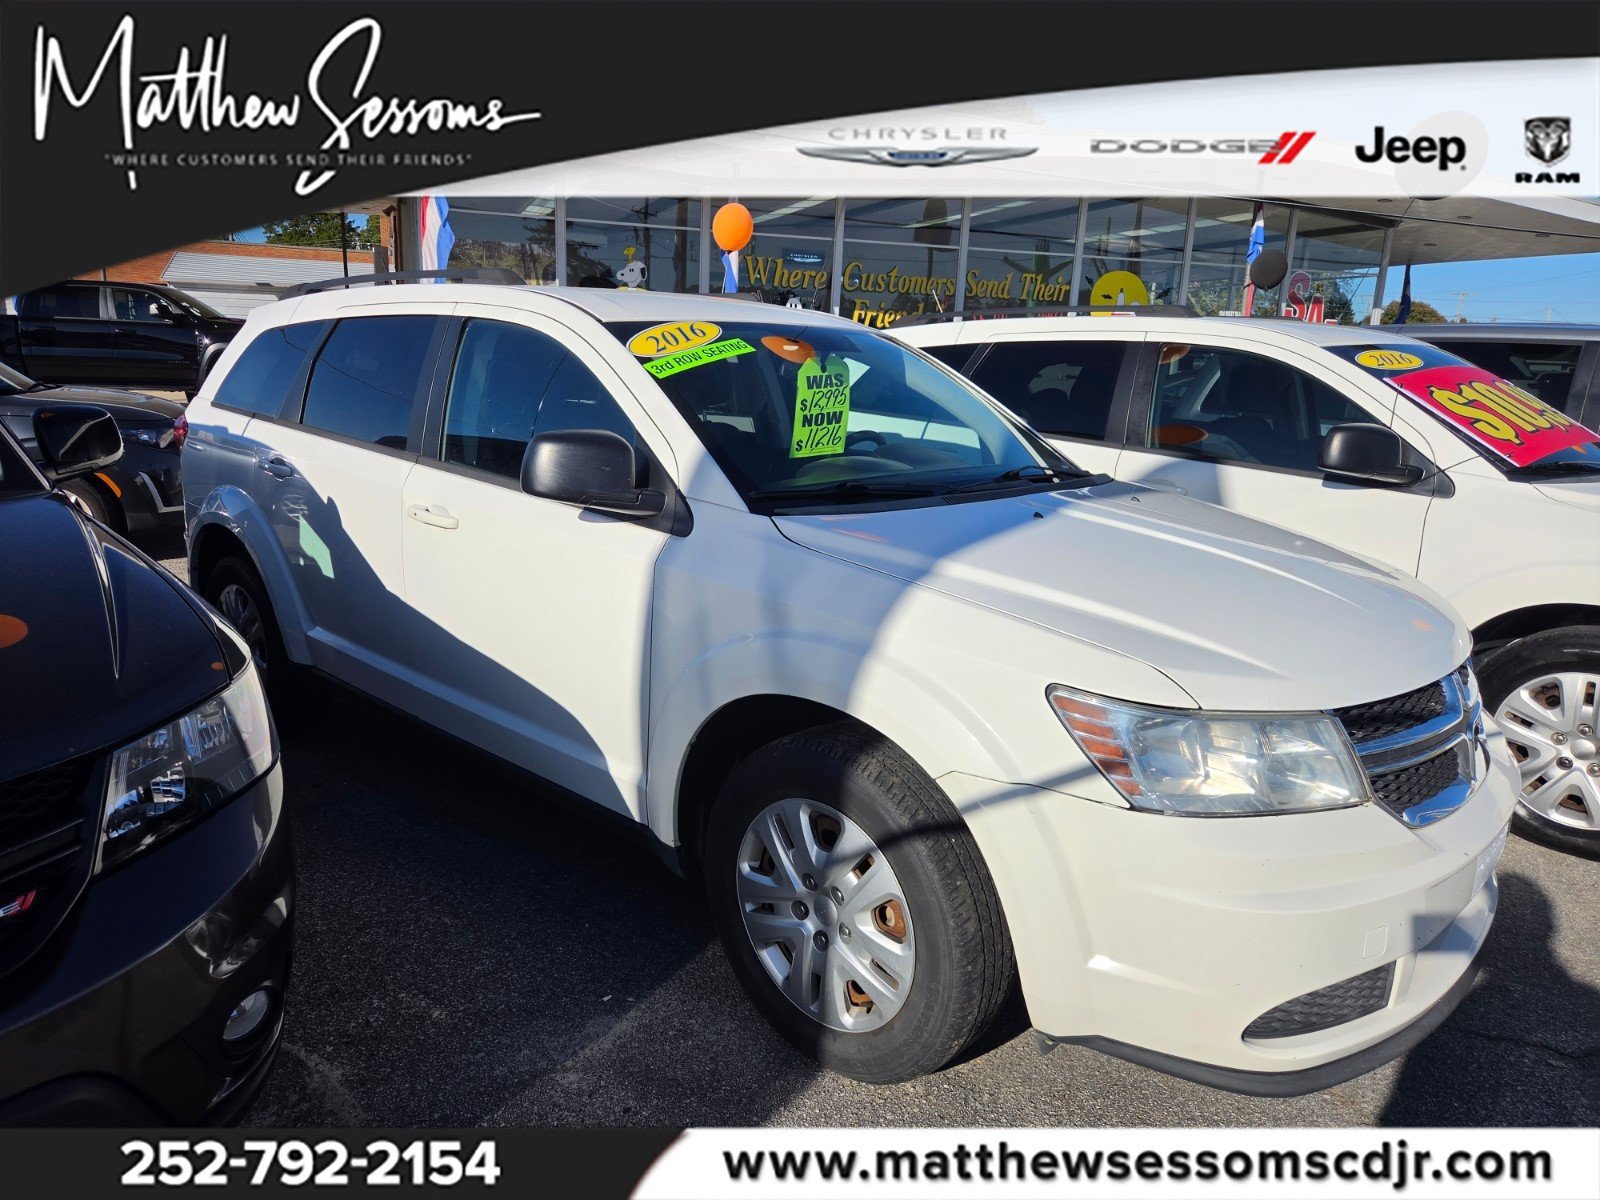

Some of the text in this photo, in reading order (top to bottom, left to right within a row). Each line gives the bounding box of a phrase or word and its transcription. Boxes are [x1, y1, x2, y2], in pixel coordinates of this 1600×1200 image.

[843, 261, 956, 296] Customers
[965, 268, 1014, 300] Send
[1020, 272, 1071, 302] Their
[852, 298, 932, 328] Frie
[1284, 271, 1338, 326] SA
[645, 322, 707, 353] 2016
[650, 340, 749, 375] 3rd ROW SEATING
[1368, 353, 1413, 367] 2016
[806, 373, 845, 390] WAS
[801, 410, 844, 428] NOW
